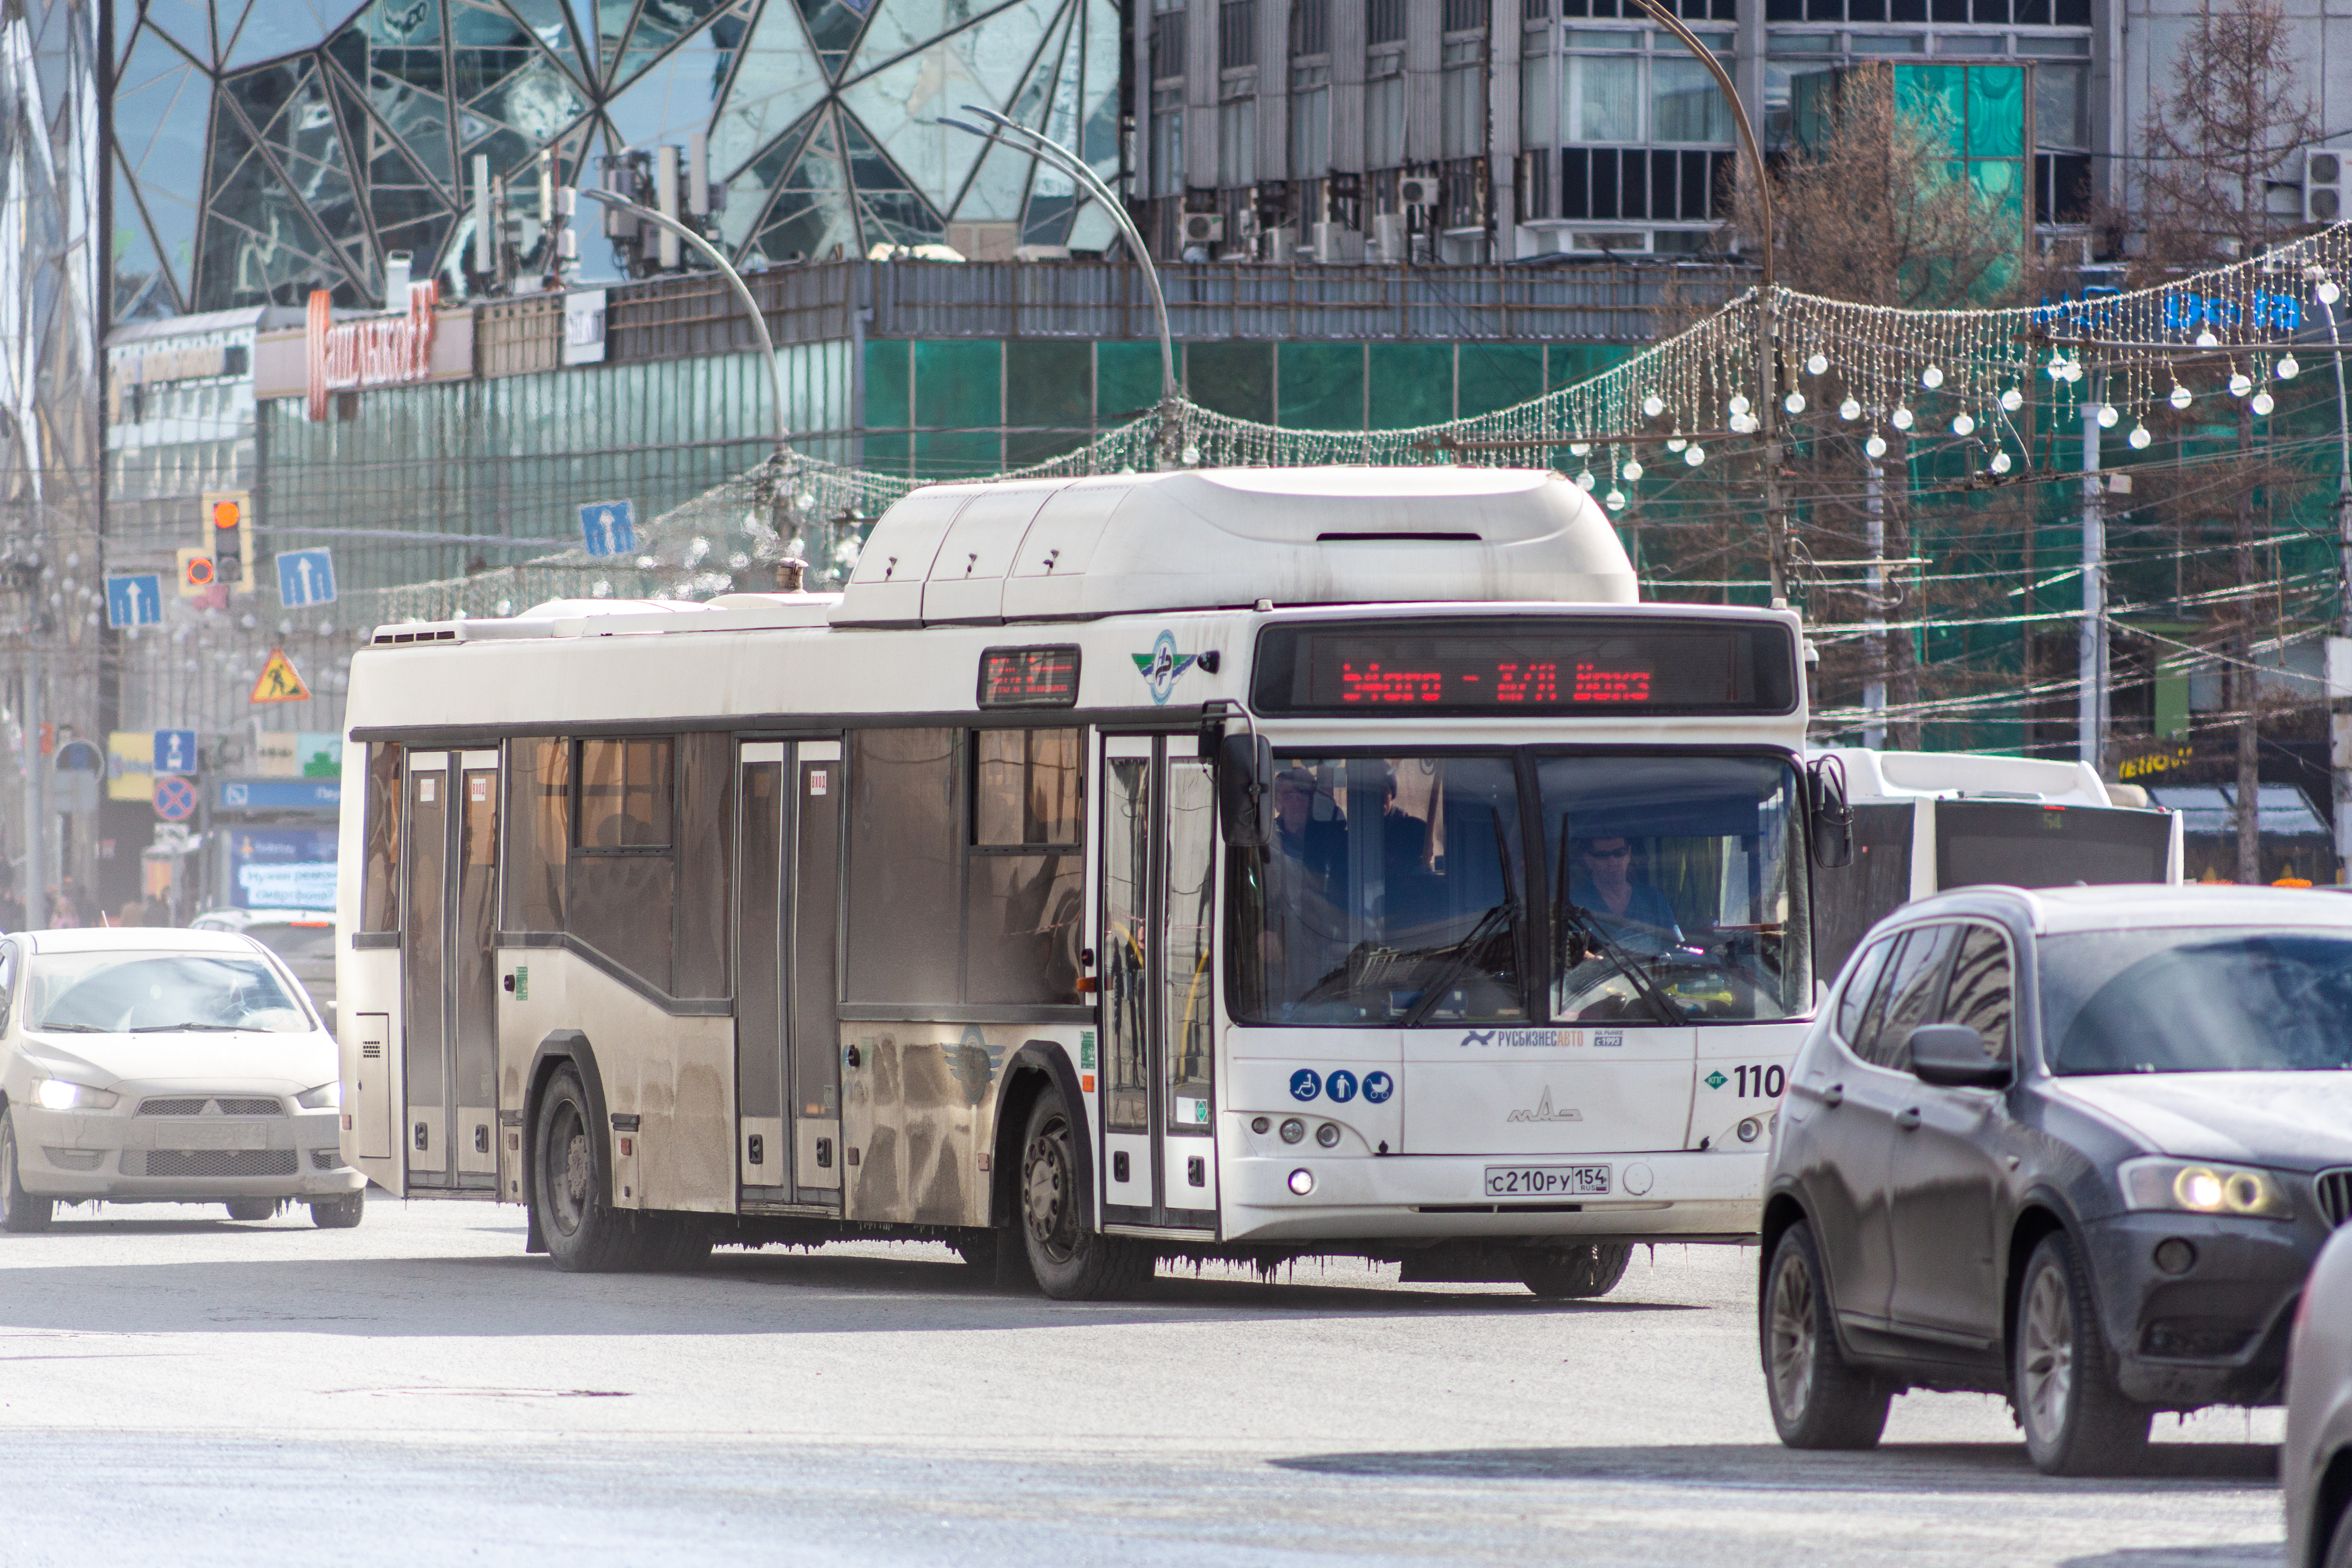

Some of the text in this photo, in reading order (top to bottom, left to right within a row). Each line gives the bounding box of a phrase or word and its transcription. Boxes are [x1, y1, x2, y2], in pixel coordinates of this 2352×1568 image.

[473, 783, 485, 796] ВХОД
[812, 776, 825, 789] ВХОД
[1498, 1030, 1583, 1047] РУСБИЗНЕСАВТО
[1708, 1076, 1725, 1084] КПГ
[1734, 1065, 1785, 1098] 110
[1575, 1169, 1604, 1185] 154
